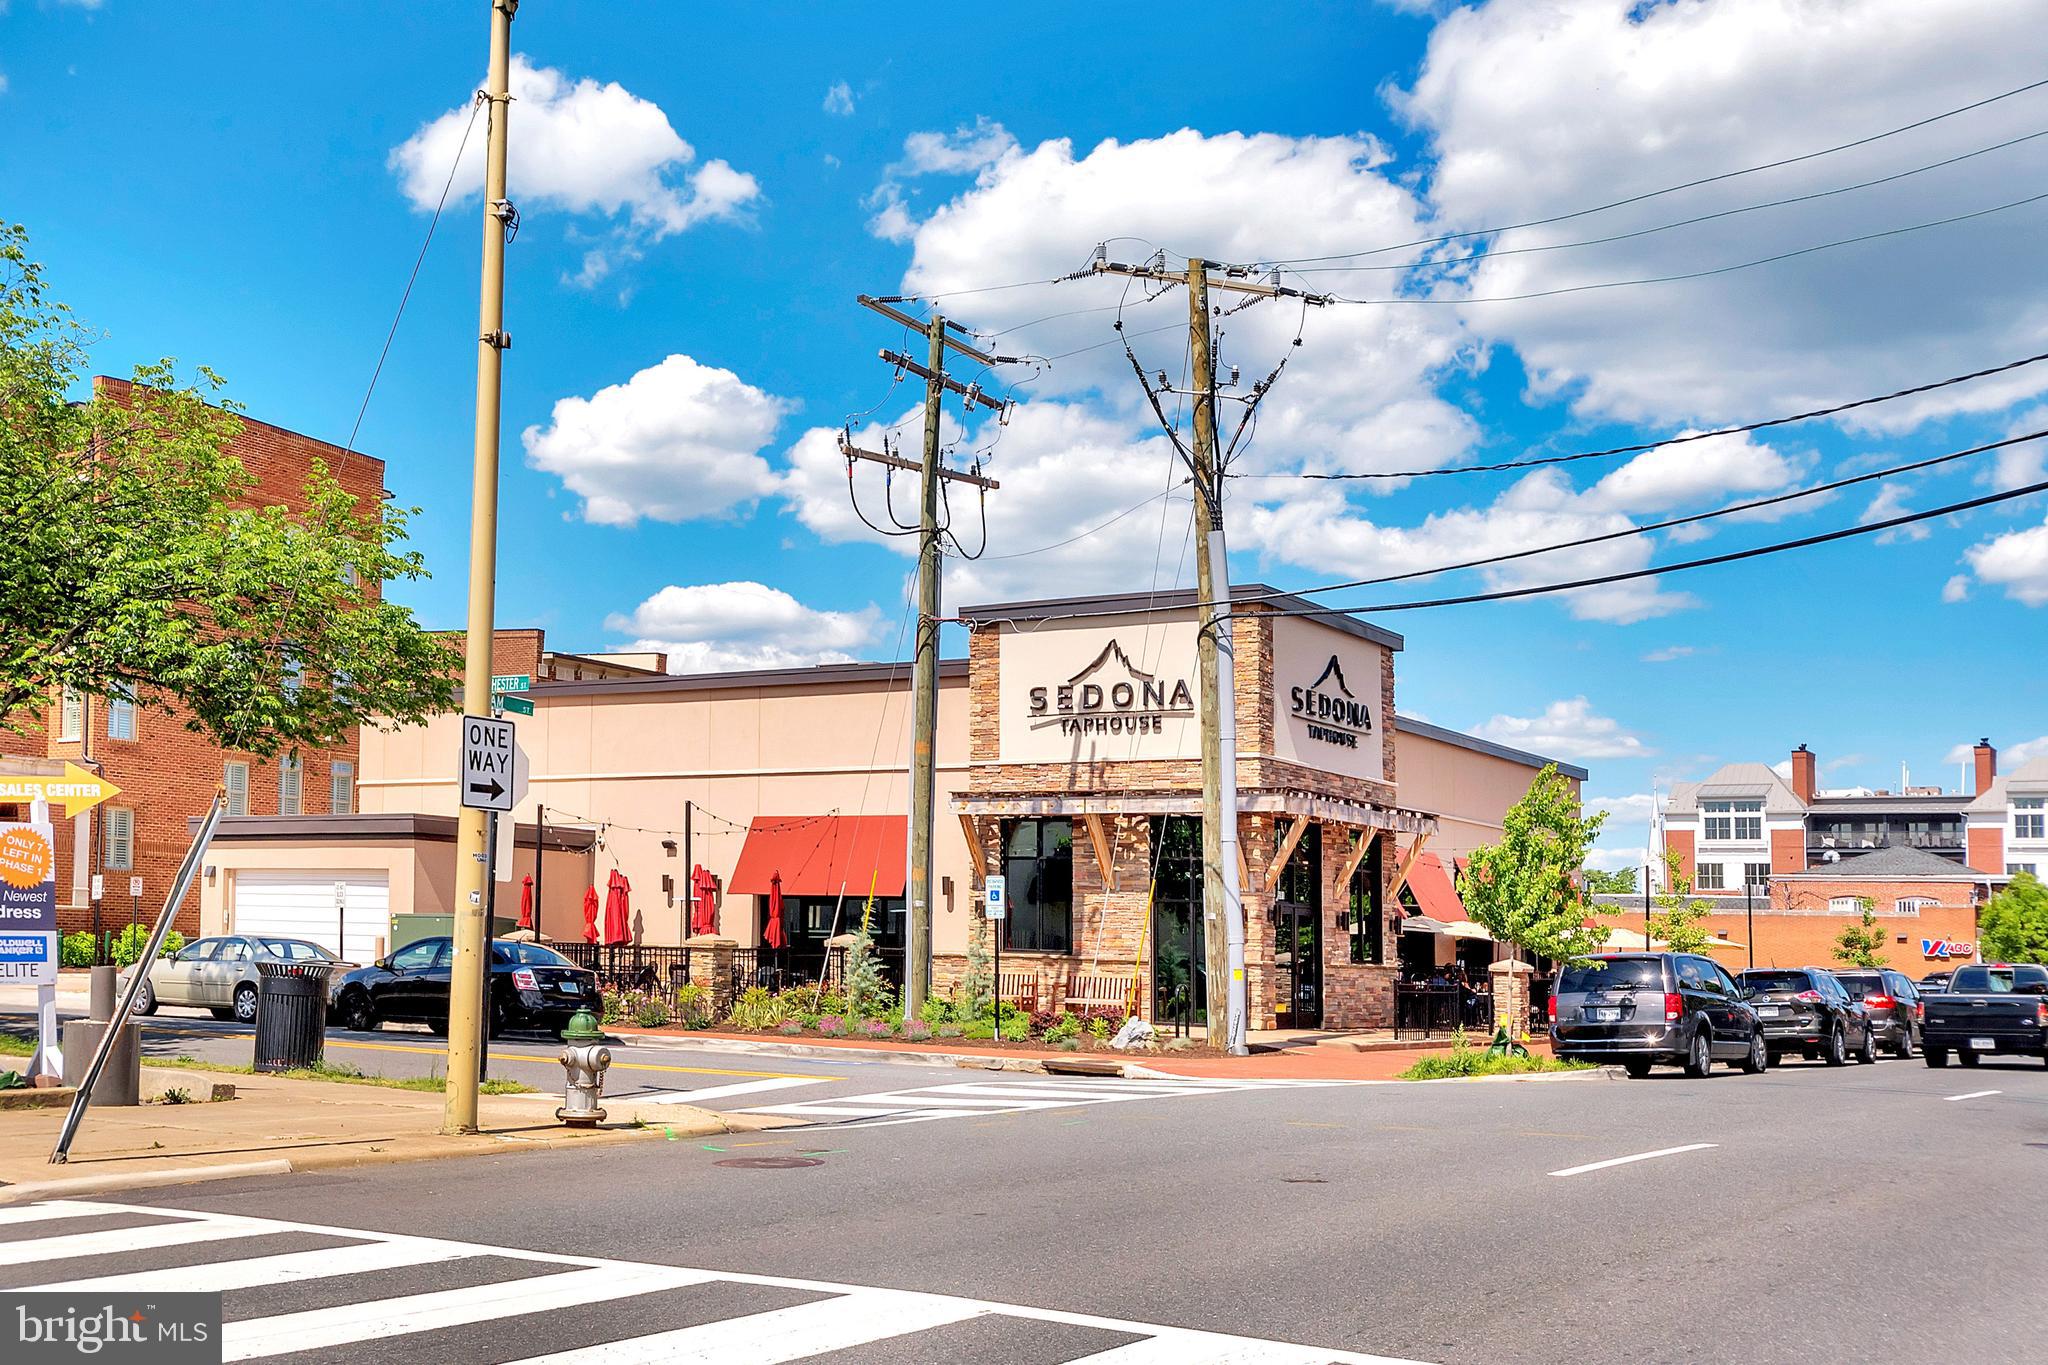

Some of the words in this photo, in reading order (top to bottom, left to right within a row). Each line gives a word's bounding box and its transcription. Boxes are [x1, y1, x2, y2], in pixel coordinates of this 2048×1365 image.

[1029, 679, 1194, 715] SEDONA
[1291, 686, 1372, 730] SEDONA
[1061, 714, 1162, 737] TAPHOUSE
[1307, 723, 1359, 749] TAPHOUSE
[470, 724, 508, 749] ONE
[469, 749, 508, 774] WAY
[0, 783, 42, 797] SALES
[46, 783, 101, 797] CENTER
[6, 835, 35, 849] ONLY
[37, 842, 43, 852] 7
[2, 846, 29, 860] LEFT
[31, 853, 43, 864] IN
[0, 857, 34, 874] PHASE
[37, 866, 42, 876] 1
[3, 890, 47, 903] Newest
[0, 963, 39, 977] ELITE
